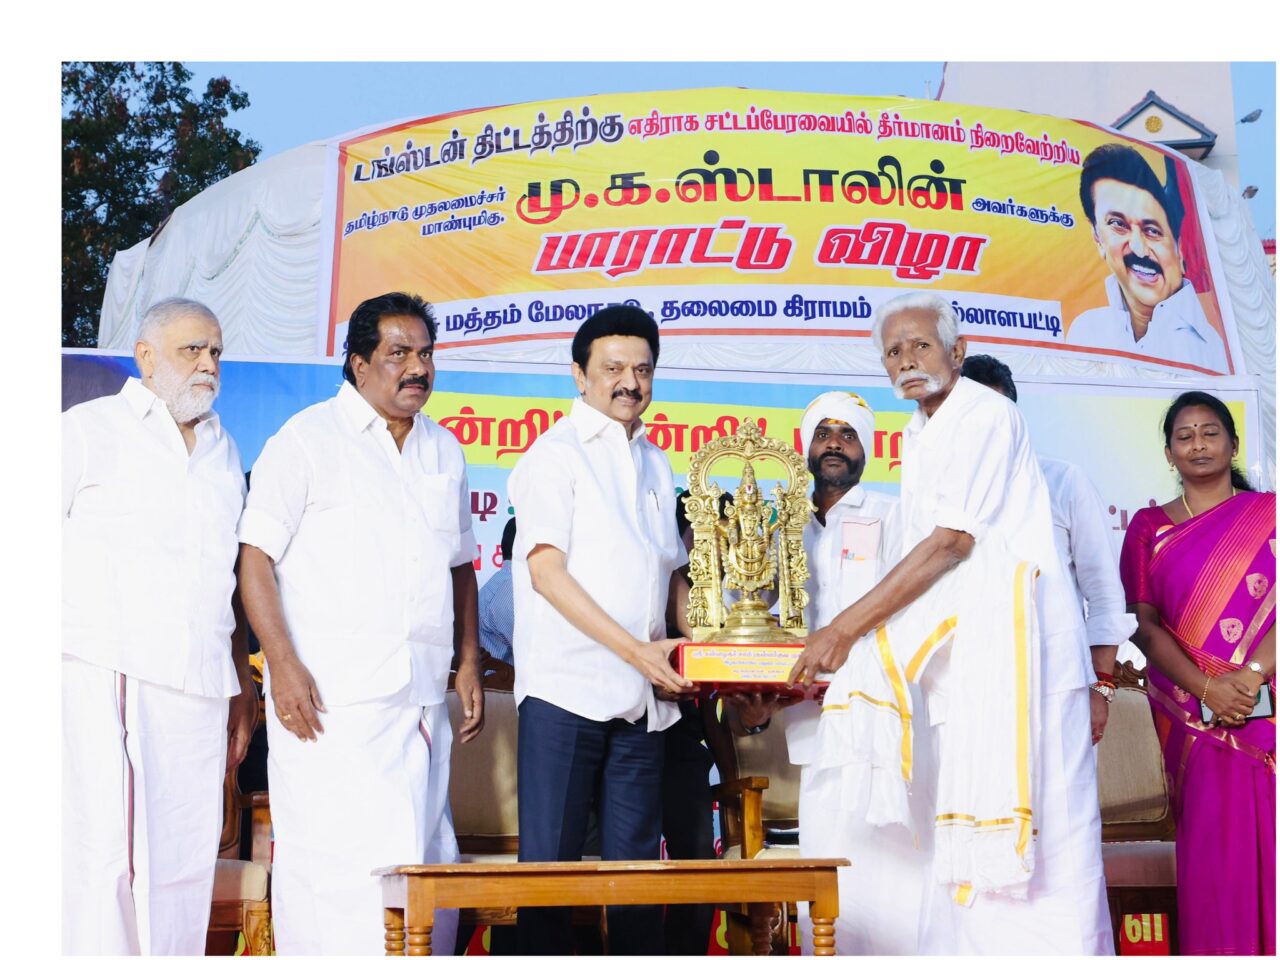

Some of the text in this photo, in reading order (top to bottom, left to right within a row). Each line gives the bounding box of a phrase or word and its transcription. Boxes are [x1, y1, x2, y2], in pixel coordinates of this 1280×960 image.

[353, 106, 1081, 182] டங்ஸ்டன் திட்டத்திற்கு எதிராக சட்டப்பேரவையில் தீர்மானம் நிறைவேற்றிய
[344, 186, 505, 237] தமிழ்நாடு முதலமைச்சர்
[516, 150, 966, 224] மு.க.ஸ்டாலின்
[971, 197, 1073, 227] அவர்களுக்கு
[535, 219, 987, 279] பாராட்டு விழா
[446, 303, 522, 336] மத்தம்
[661, 298, 776, 323] தலைமை
[782, 294, 871, 321] கிராமம்
